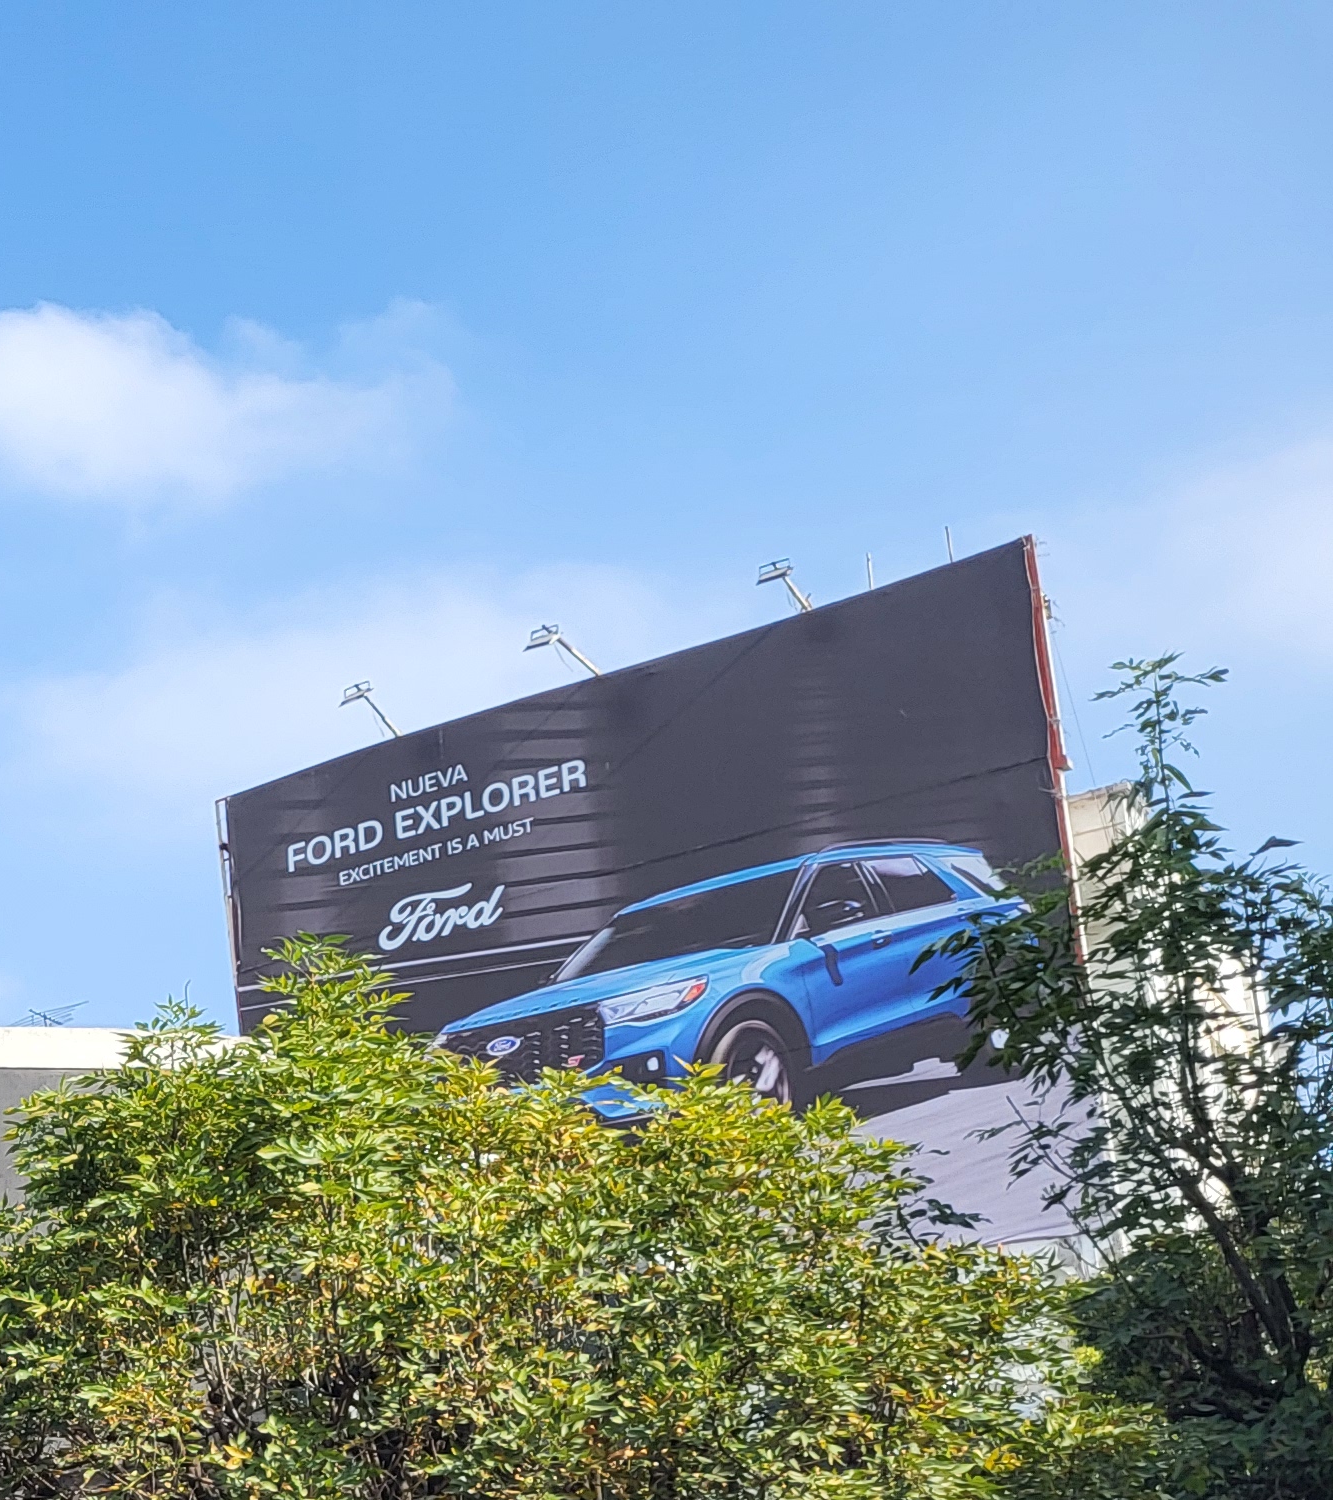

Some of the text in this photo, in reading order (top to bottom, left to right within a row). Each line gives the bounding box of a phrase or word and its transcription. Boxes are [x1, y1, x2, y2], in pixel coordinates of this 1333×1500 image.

[287, 759, 588, 873] FORD EXPLORER
[389, 764, 468, 802] NUEVA
[338, 817, 534, 886] EXCITEMENT IS A MUST
[378, 882, 505, 950] Ford
